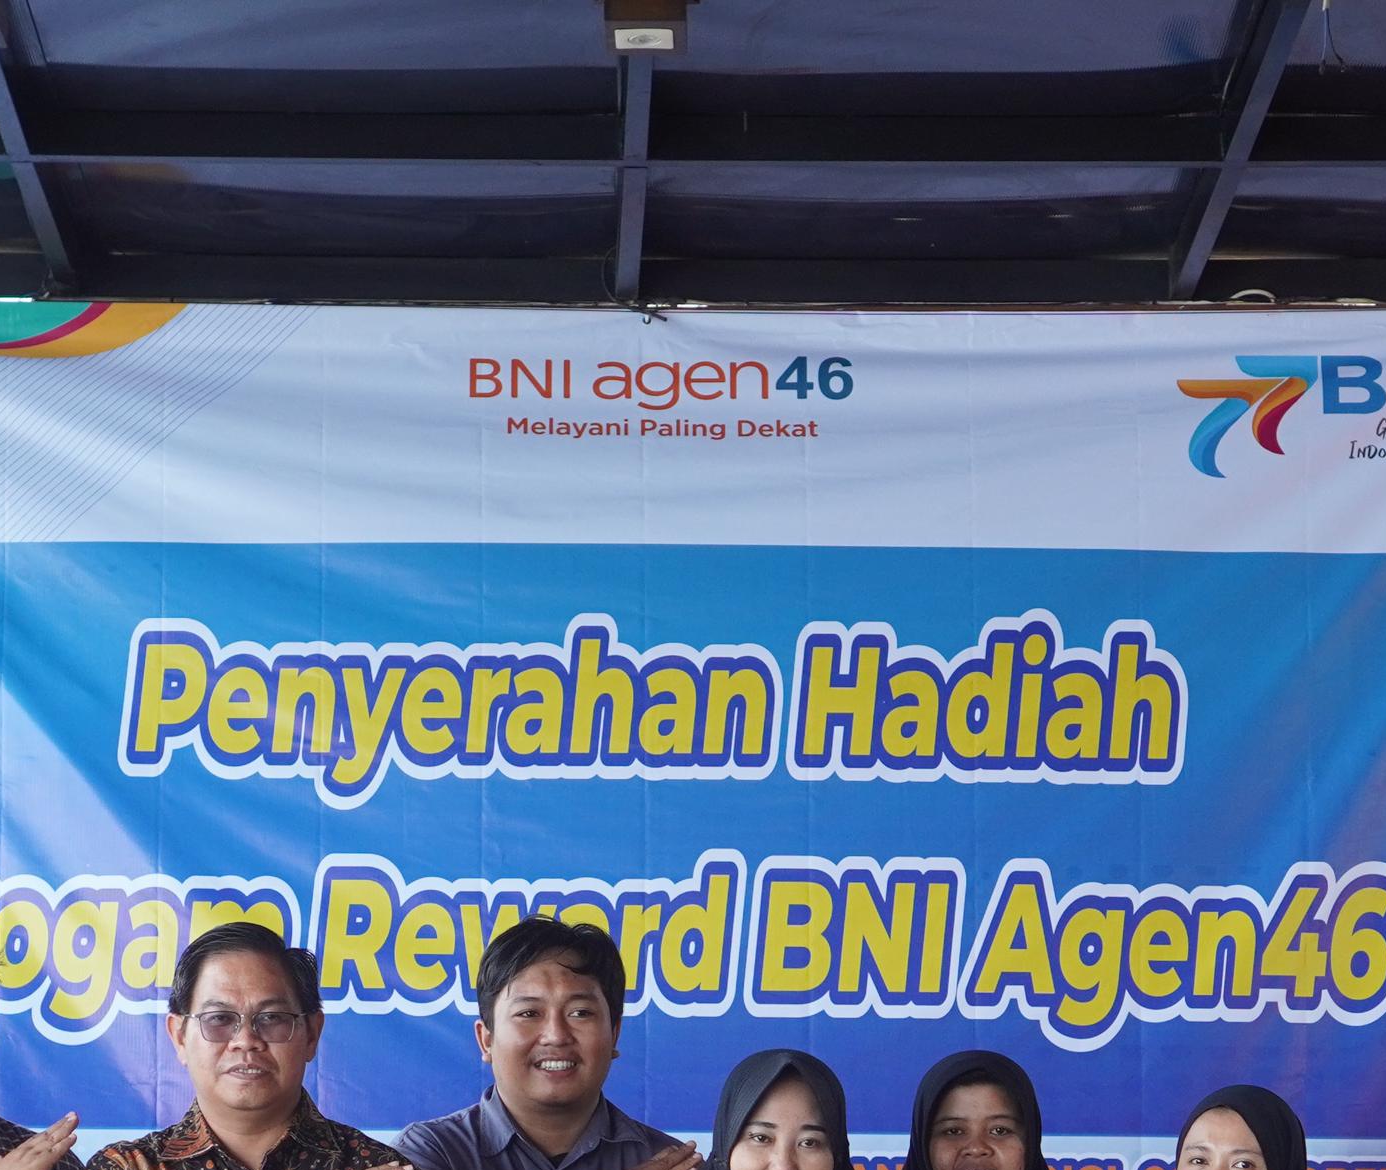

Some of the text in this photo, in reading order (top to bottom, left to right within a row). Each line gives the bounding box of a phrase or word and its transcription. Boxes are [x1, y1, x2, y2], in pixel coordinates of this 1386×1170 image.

[468, 355, 855, 411] BNI agen46
[506, 416, 819, 441] Melayani Paling Dekat
[129, 626, 1179, 792] Penyerahan Hadiah
[313, 870, 737, 998] Rerd
[755, 874, 955, 1000] BNI
